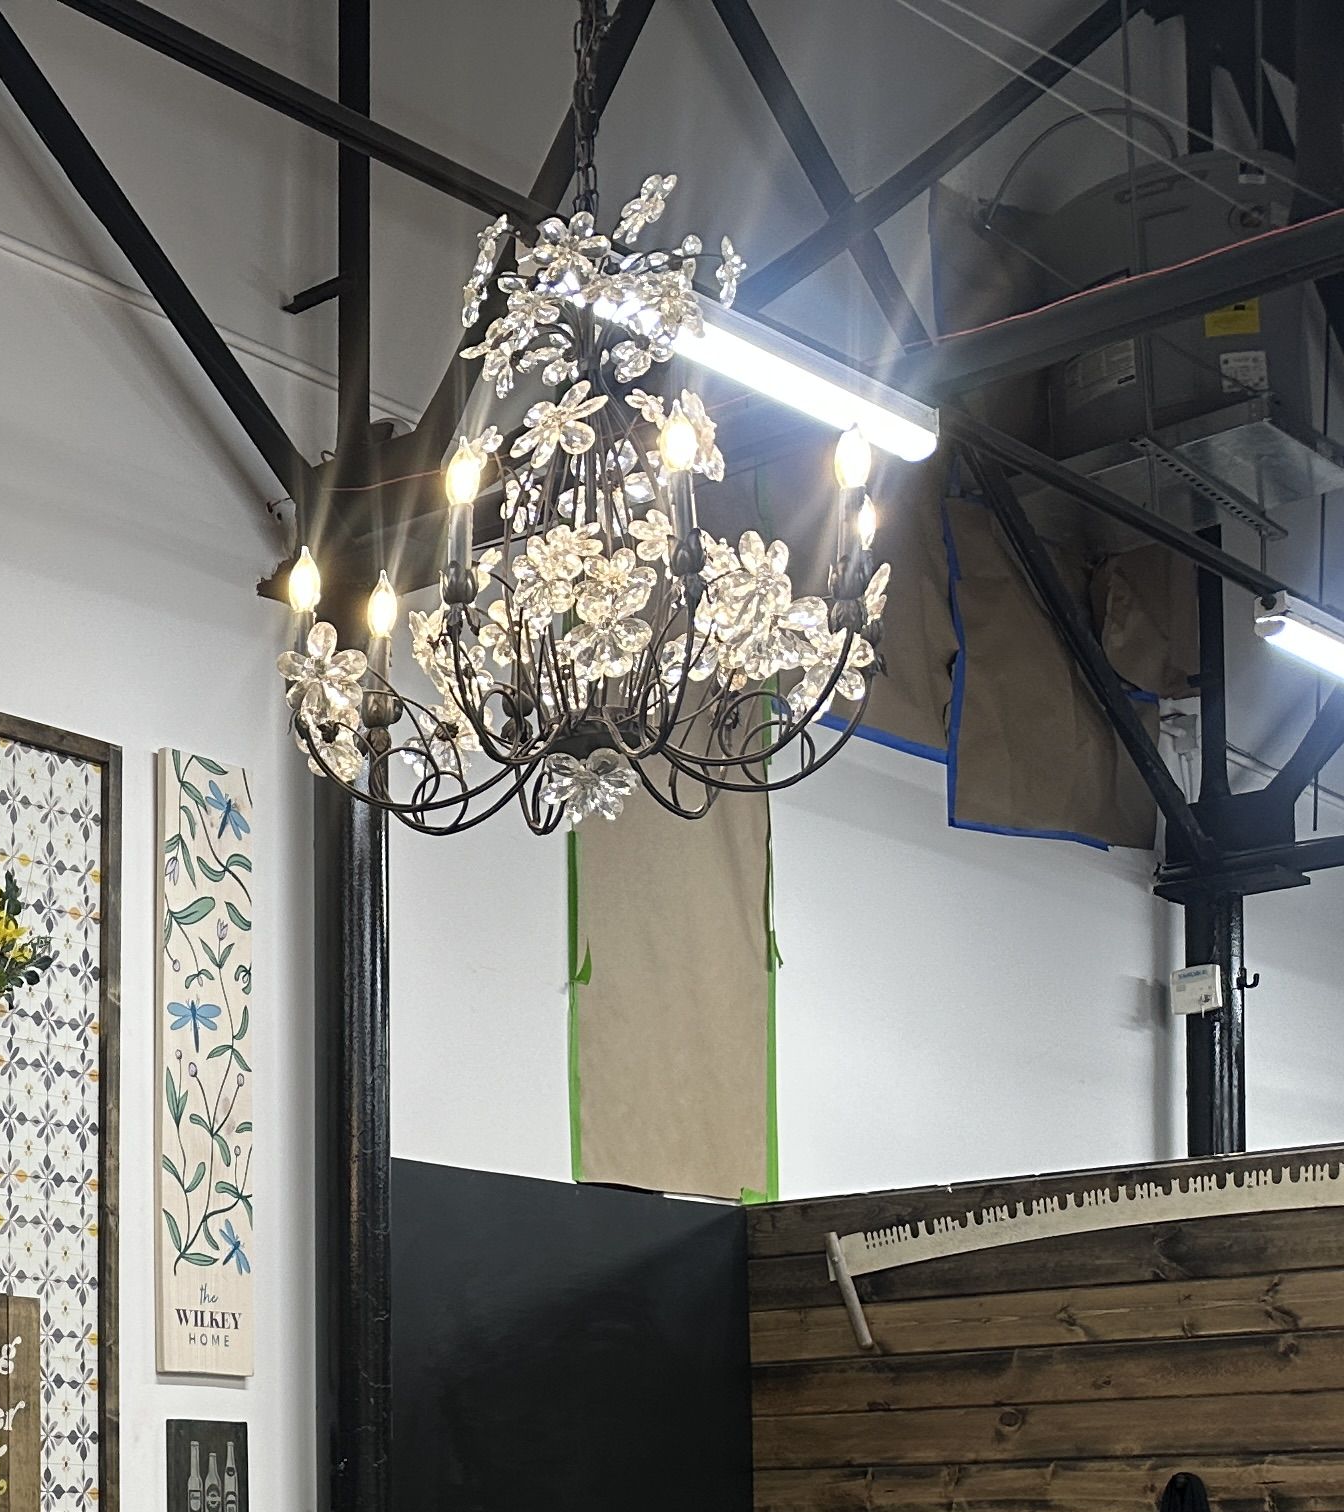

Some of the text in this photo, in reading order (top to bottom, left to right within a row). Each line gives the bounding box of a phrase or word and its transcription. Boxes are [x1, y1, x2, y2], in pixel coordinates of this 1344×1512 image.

[199, 1283, 220, 1306] the
[175, 1308, 243, 1331] WILKEY
[188, 1333, 231, 1348] HOME
